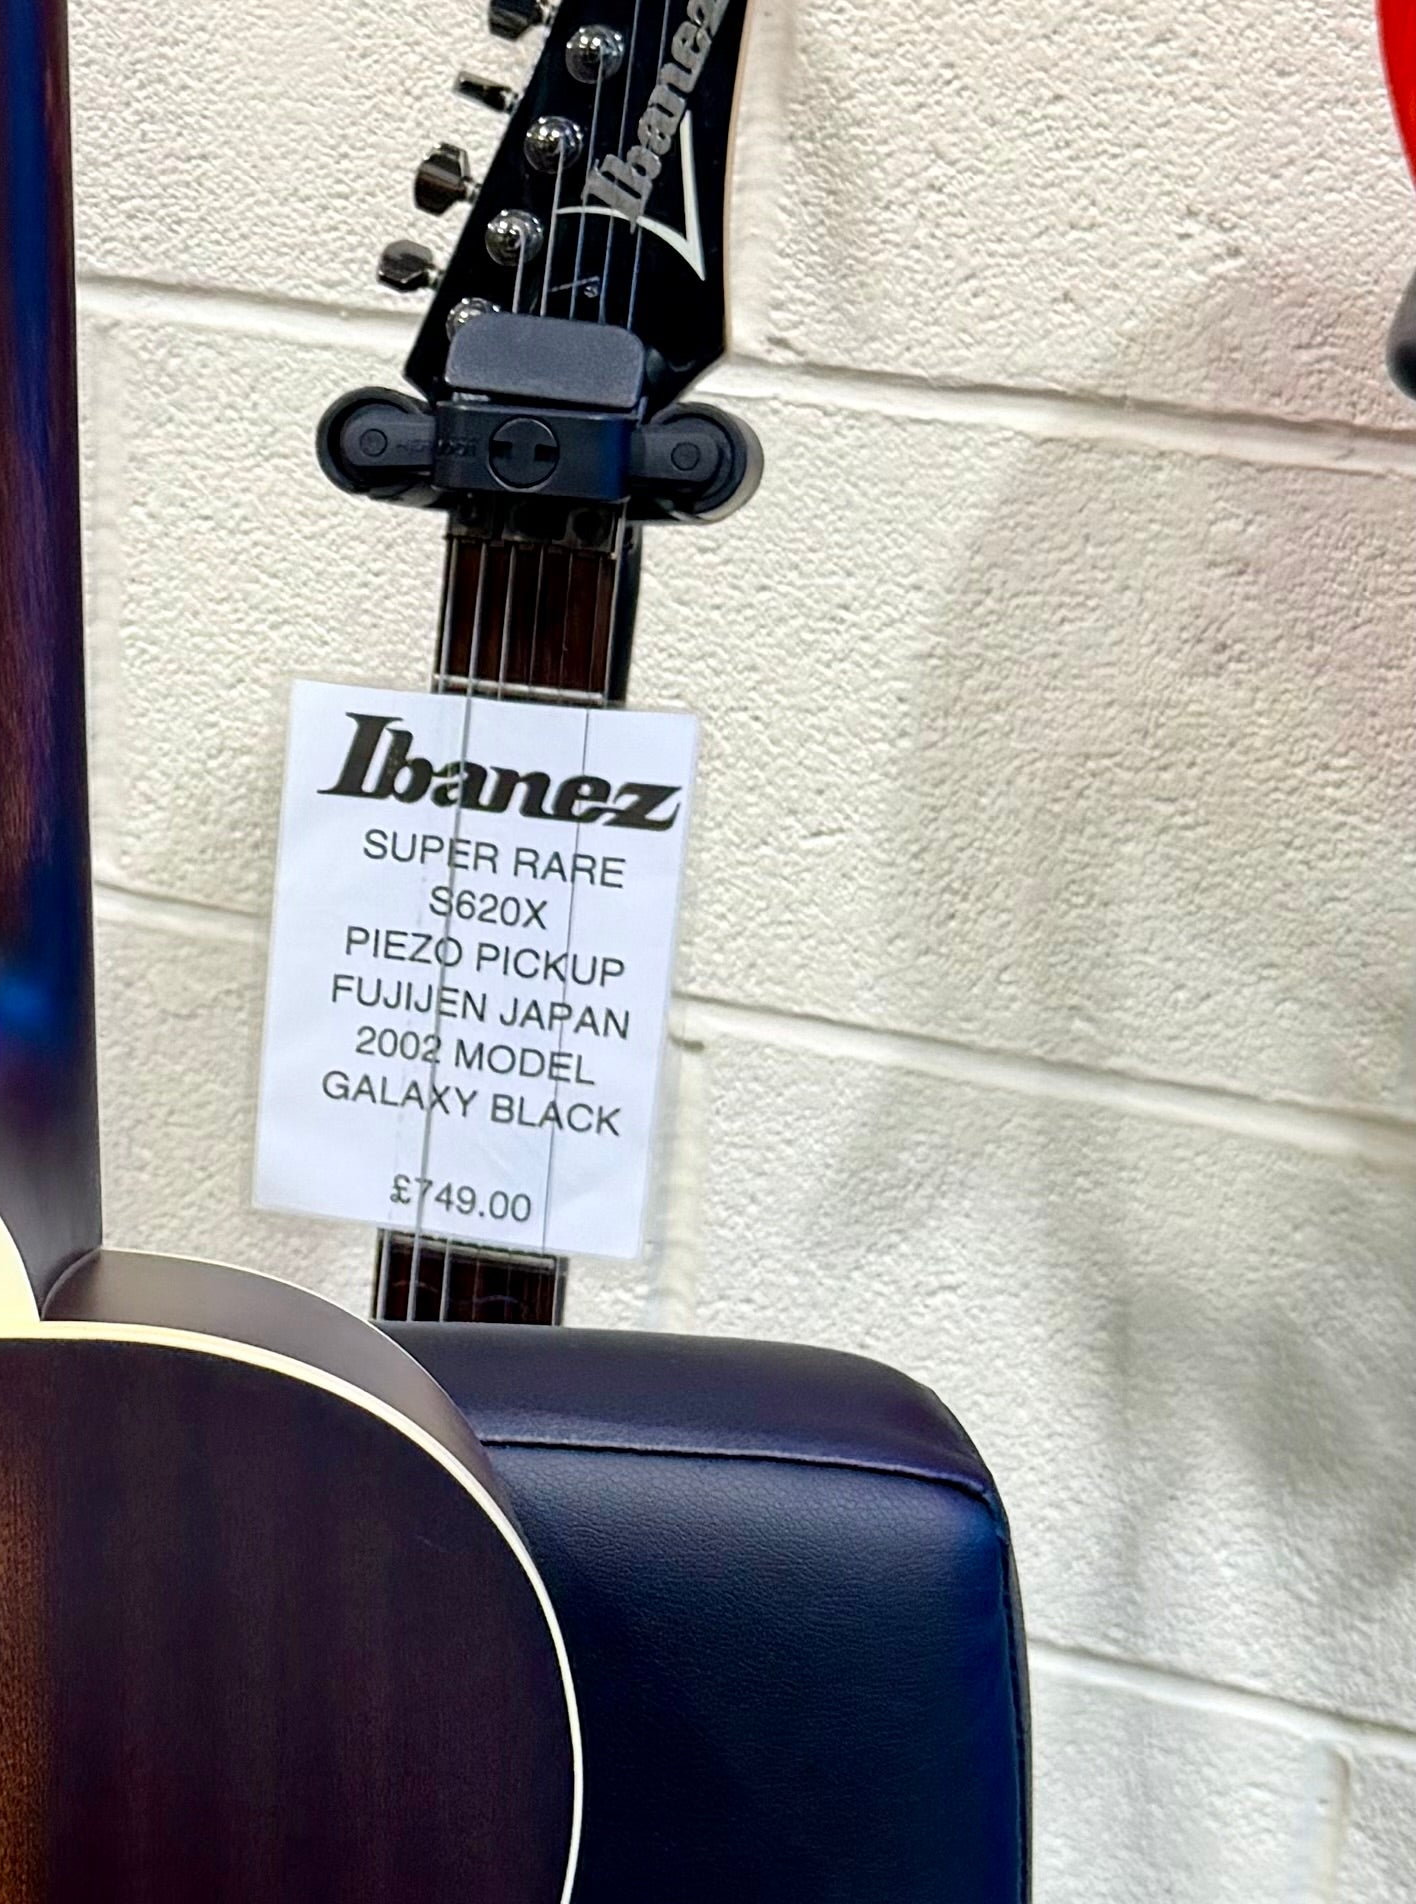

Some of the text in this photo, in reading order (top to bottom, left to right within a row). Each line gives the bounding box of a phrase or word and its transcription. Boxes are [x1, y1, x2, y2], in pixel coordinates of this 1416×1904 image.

[316, 712, 683, 832] Ibanez
[363, 829, 627, 889] SUPER RARE
[428, 887, 549, 931] S620X
[345, 927, 625, 988] PIEZO PICKUP
[331, 975, 631, 1040] FUJIJEN JAPAN
[355, 1027, 596, 1086] 2002 MODEL
[321, 1070, 623, 1137] GALAXY BLACK
[389, 1174, 533, 1224] £749.00
